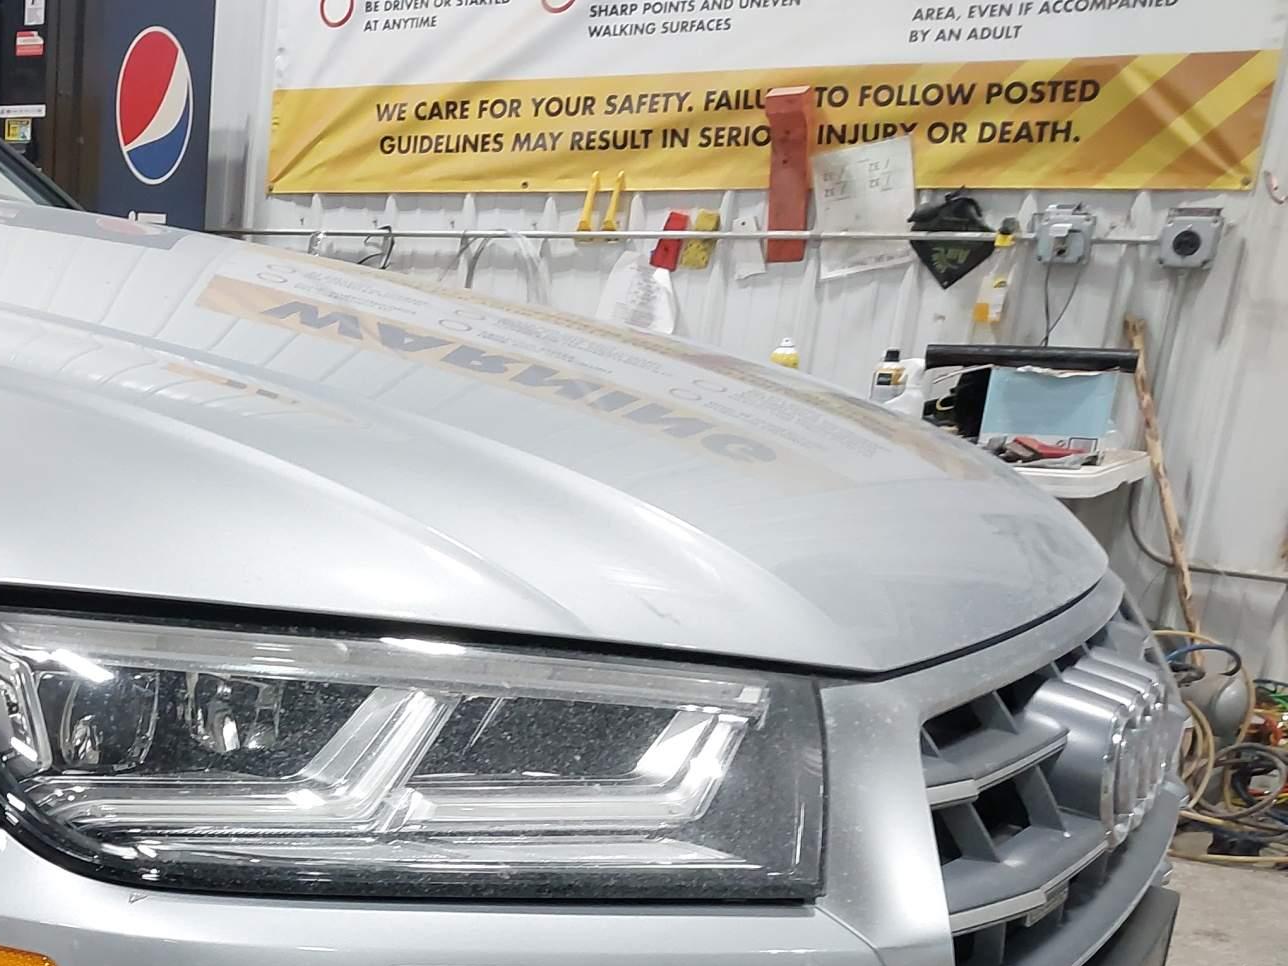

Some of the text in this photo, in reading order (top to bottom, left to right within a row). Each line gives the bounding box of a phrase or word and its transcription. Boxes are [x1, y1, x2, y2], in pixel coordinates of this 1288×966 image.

[364, 0, 380, 13] BE
[383, 0, 430, 12] DRIVEN
[433, 0, 452, 9] OR
[589, 0, 801, 18] SHARP POINTS AND UNEVEN
[911, 6, 961, 22] AREA,
[967, 3, 1014, 19] EVEN
[1017, 1, 1034, 17] IF
[363, 15, 437, 33] AT ANYTIME
[588, 17, 732, 38] WALKING SURFACES
[908, 24, 1023, 43] BY AN ADULT
[375, 79, 1101, 122] WE CARE FOR YOUR SAFETY. FAILU TO FOLLOW POSTED
[379, 120, 1081, 155] GUIDELINES MAY RESULT IN SERIO INJURY OR DEATH.
